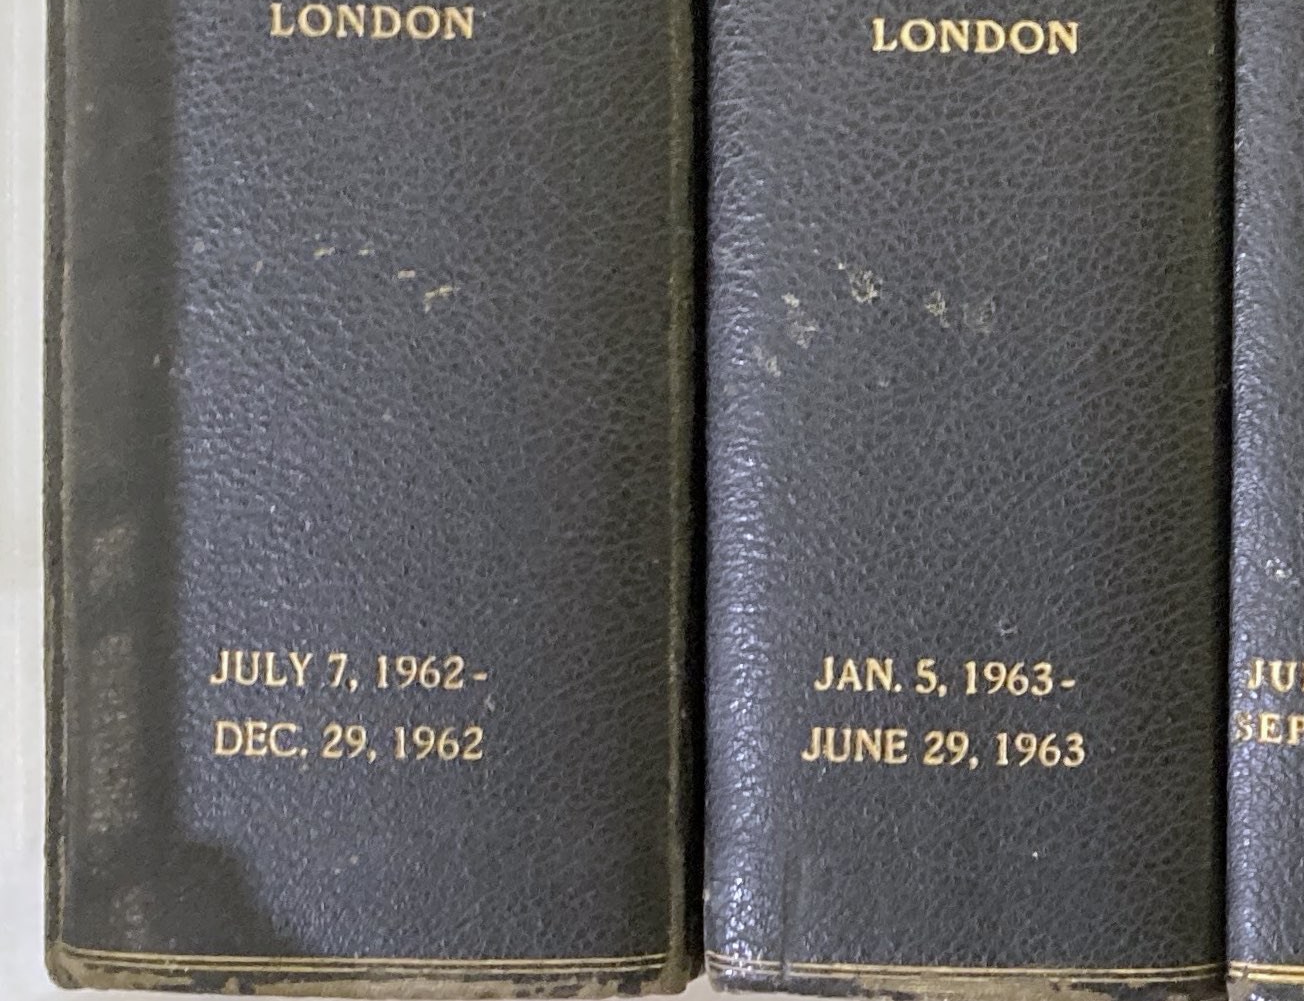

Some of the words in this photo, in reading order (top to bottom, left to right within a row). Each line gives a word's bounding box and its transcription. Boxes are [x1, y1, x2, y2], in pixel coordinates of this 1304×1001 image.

[271, 2, 473, 40] LONDON
[871, 16, 1078, 55] LONDON
[210, 650, 314, 686] JULY
[329, 652, 355, 688] 7,
[377, 655, 485, 689] 1962-
[815, 657, 899, 691] JAN.
[915, 659, 945, 696] 5,
[964, 661, 1073, 696] 1963-
[215, 720, 304, 756] DEC.
[321, 723, 374, 760] 29,
[395, 725, 483, 760] 1962
[801, 727, 906, 764] JUNE
[923, 731, 976, 768] 29,
[997, 732, 1083, 766] 1963
